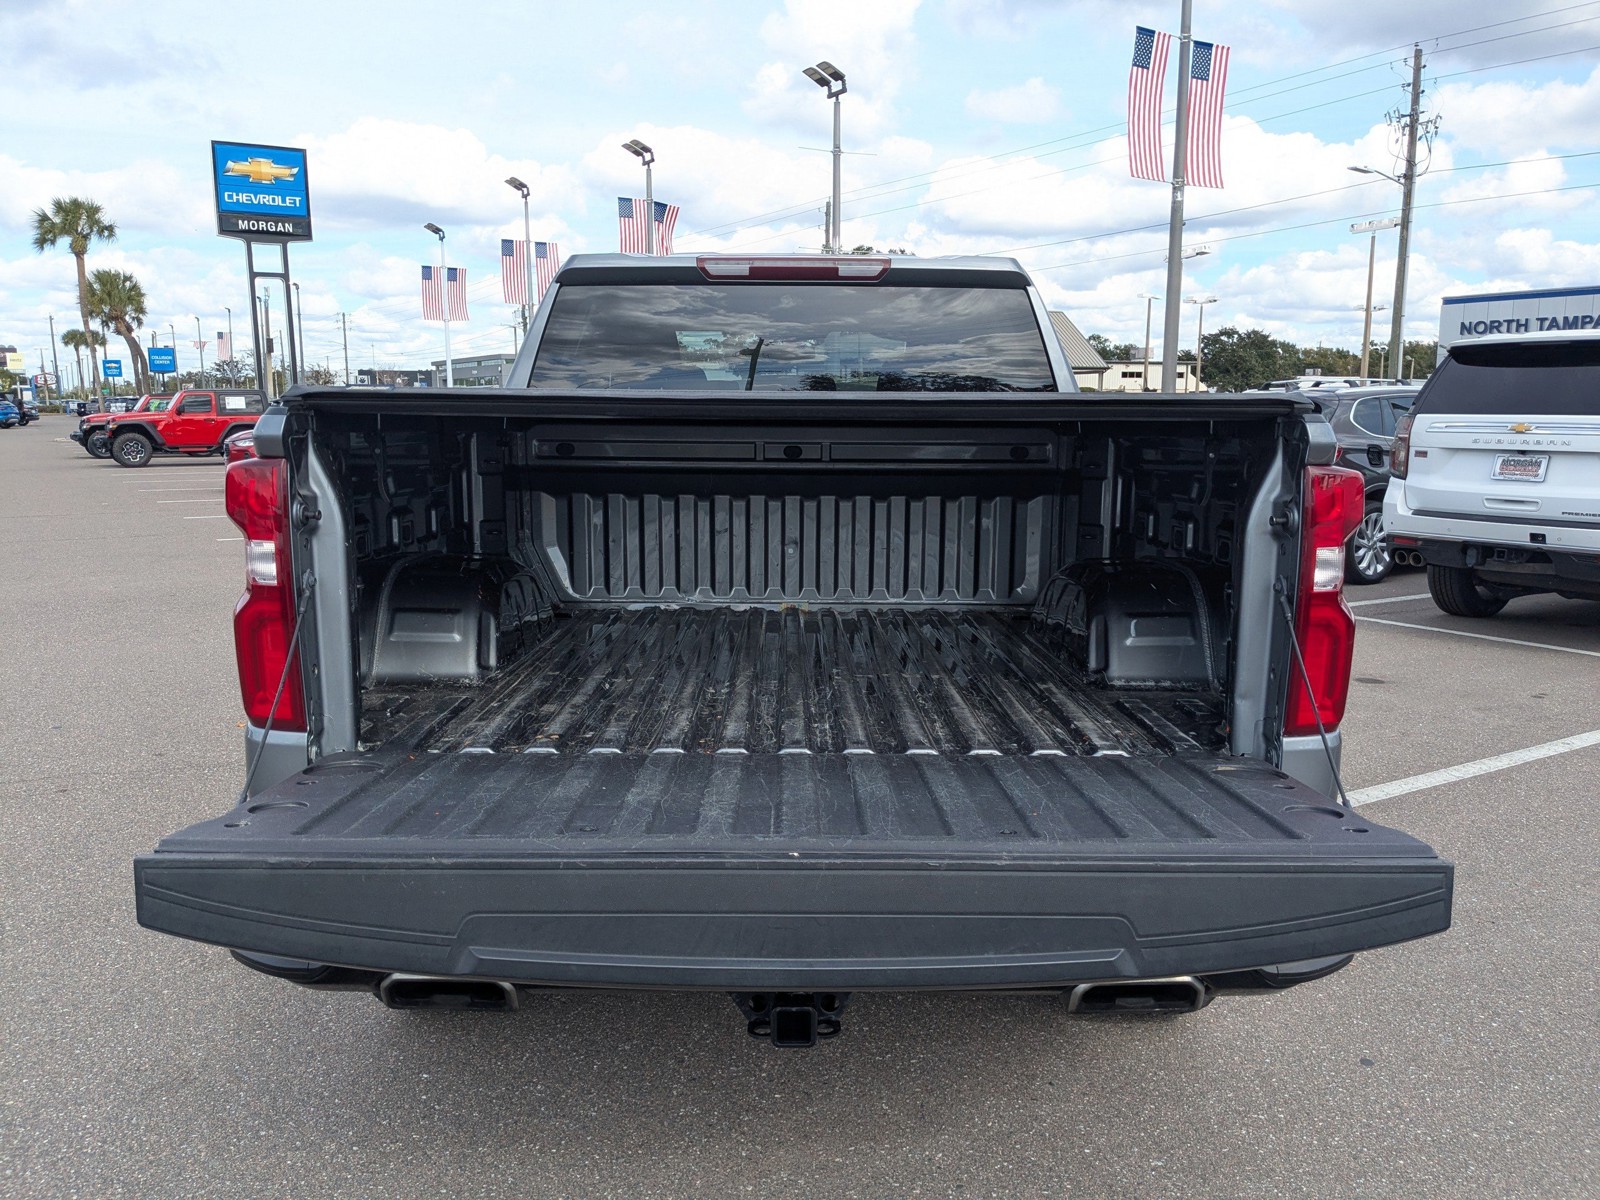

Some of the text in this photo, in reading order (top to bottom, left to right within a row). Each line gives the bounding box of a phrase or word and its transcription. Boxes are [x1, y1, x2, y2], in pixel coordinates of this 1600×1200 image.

[224, 191, 302, 207] CHEVROLET
[238, 219, 293, 233] MORGAN
[1460, 318, 1530, 336] NORTH
[1472, 438, 1572, 446] SUBURBAN
[1501, 458, 1543, 467] MORGAN
